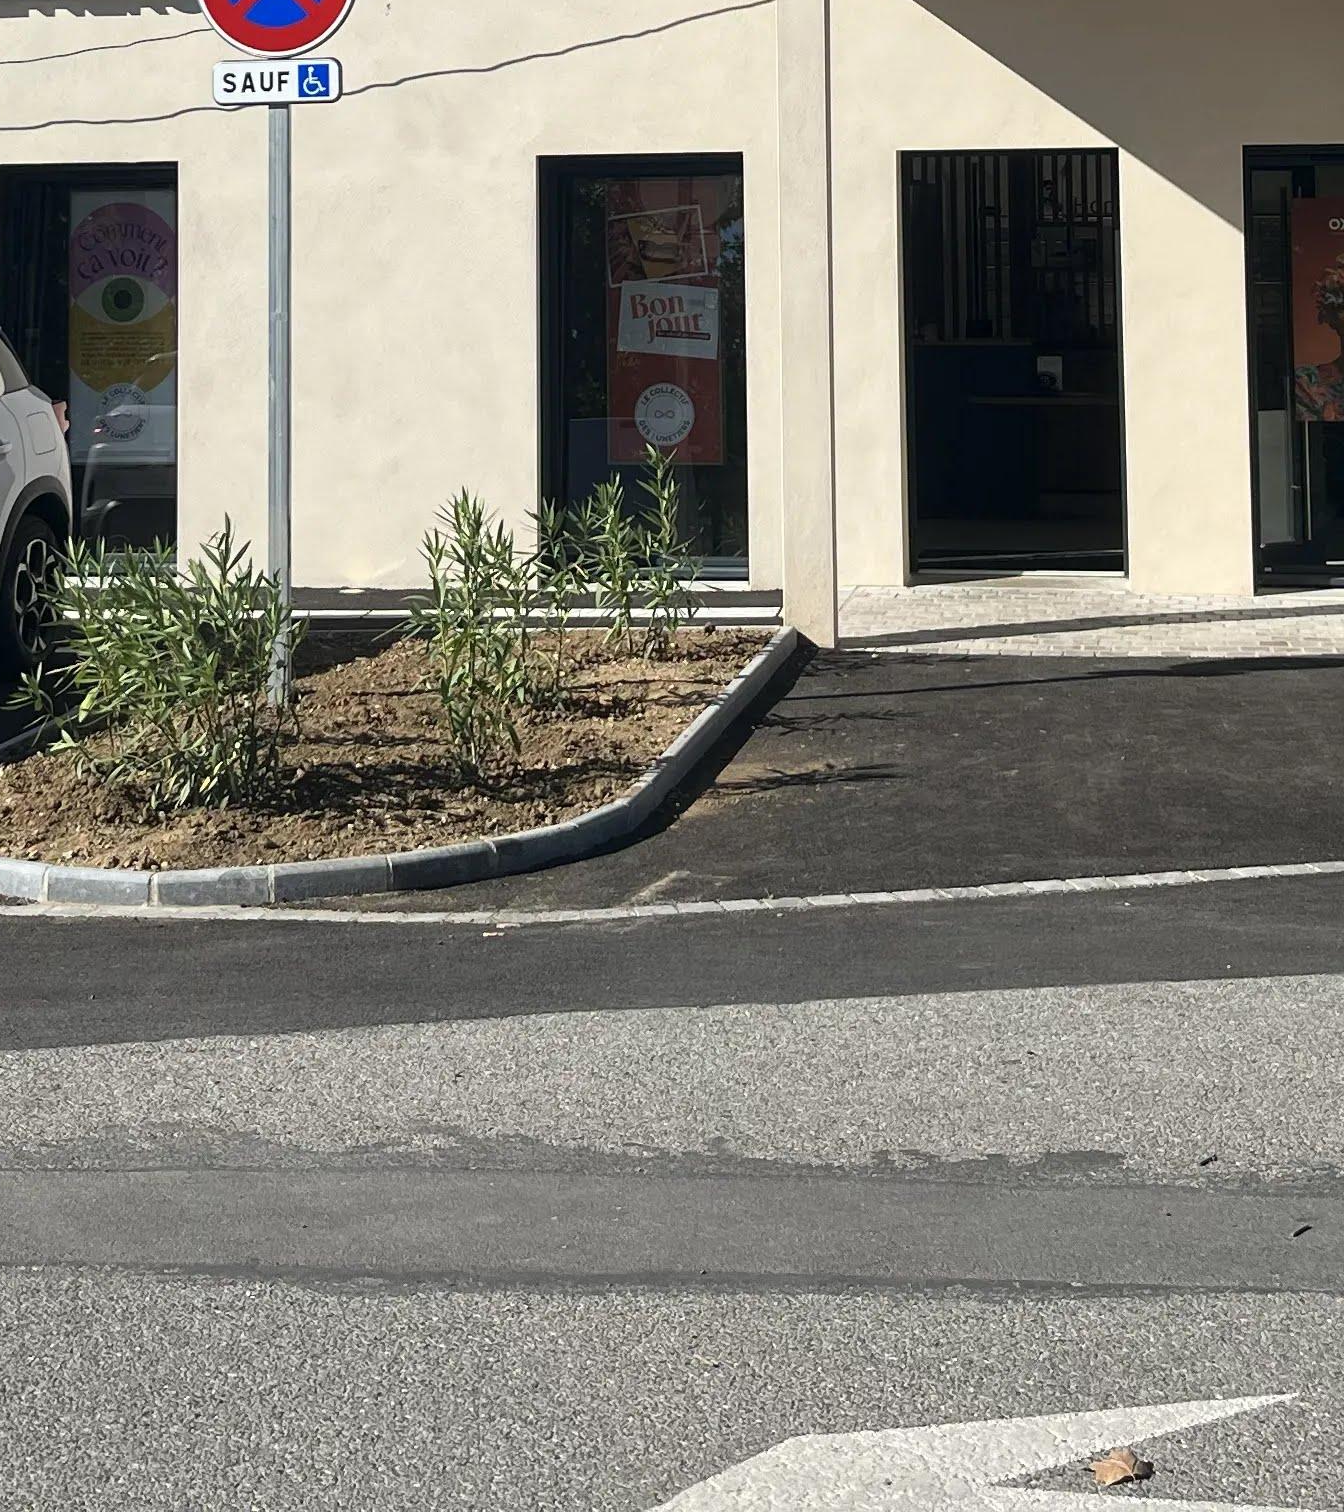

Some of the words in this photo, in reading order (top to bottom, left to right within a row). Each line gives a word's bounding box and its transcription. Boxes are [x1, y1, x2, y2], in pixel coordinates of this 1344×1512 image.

[222, 71, 290, 94] SAUF
[78, 223, 167, 251] Comment
[630, 294, 684, 320] Bon
[647, 312, 703, 345] jour
